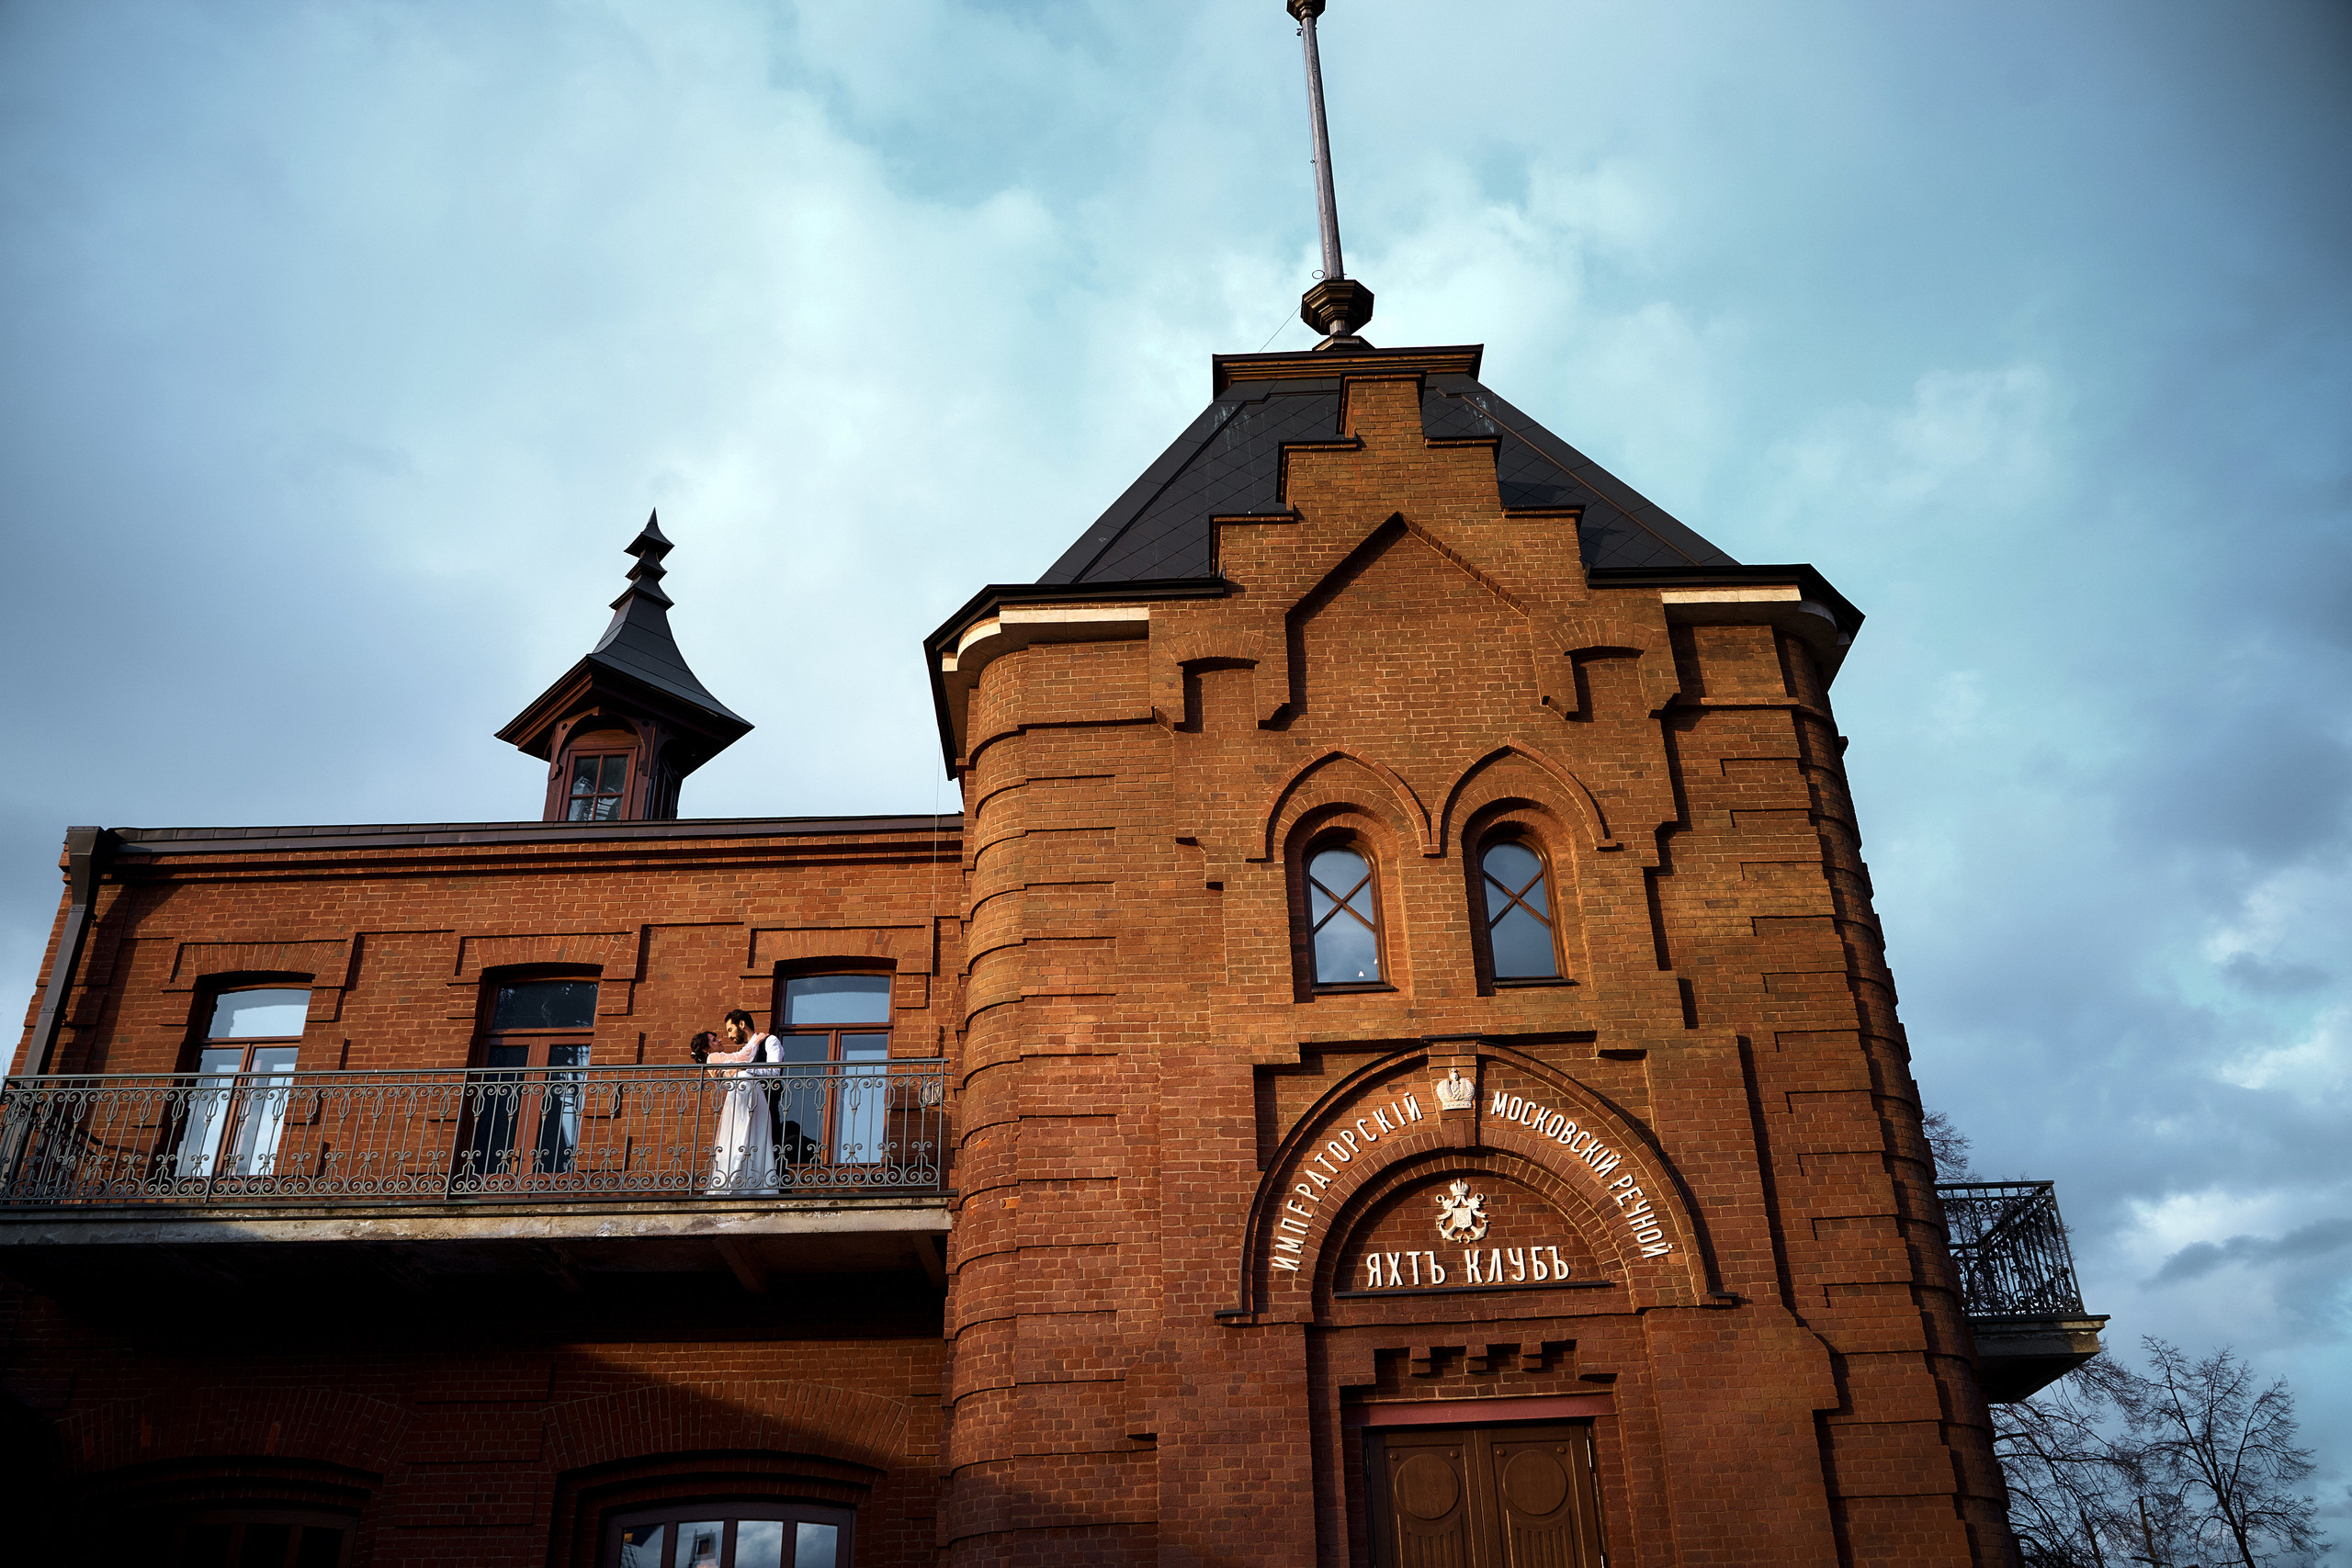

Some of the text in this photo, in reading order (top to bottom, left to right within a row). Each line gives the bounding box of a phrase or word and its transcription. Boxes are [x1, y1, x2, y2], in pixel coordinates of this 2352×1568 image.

[1609, 1174, 1674, 1259] РЕЧНОЙ
[1366, 1246, 1569, 1287] ЯХТЪ КЛУБЪ
